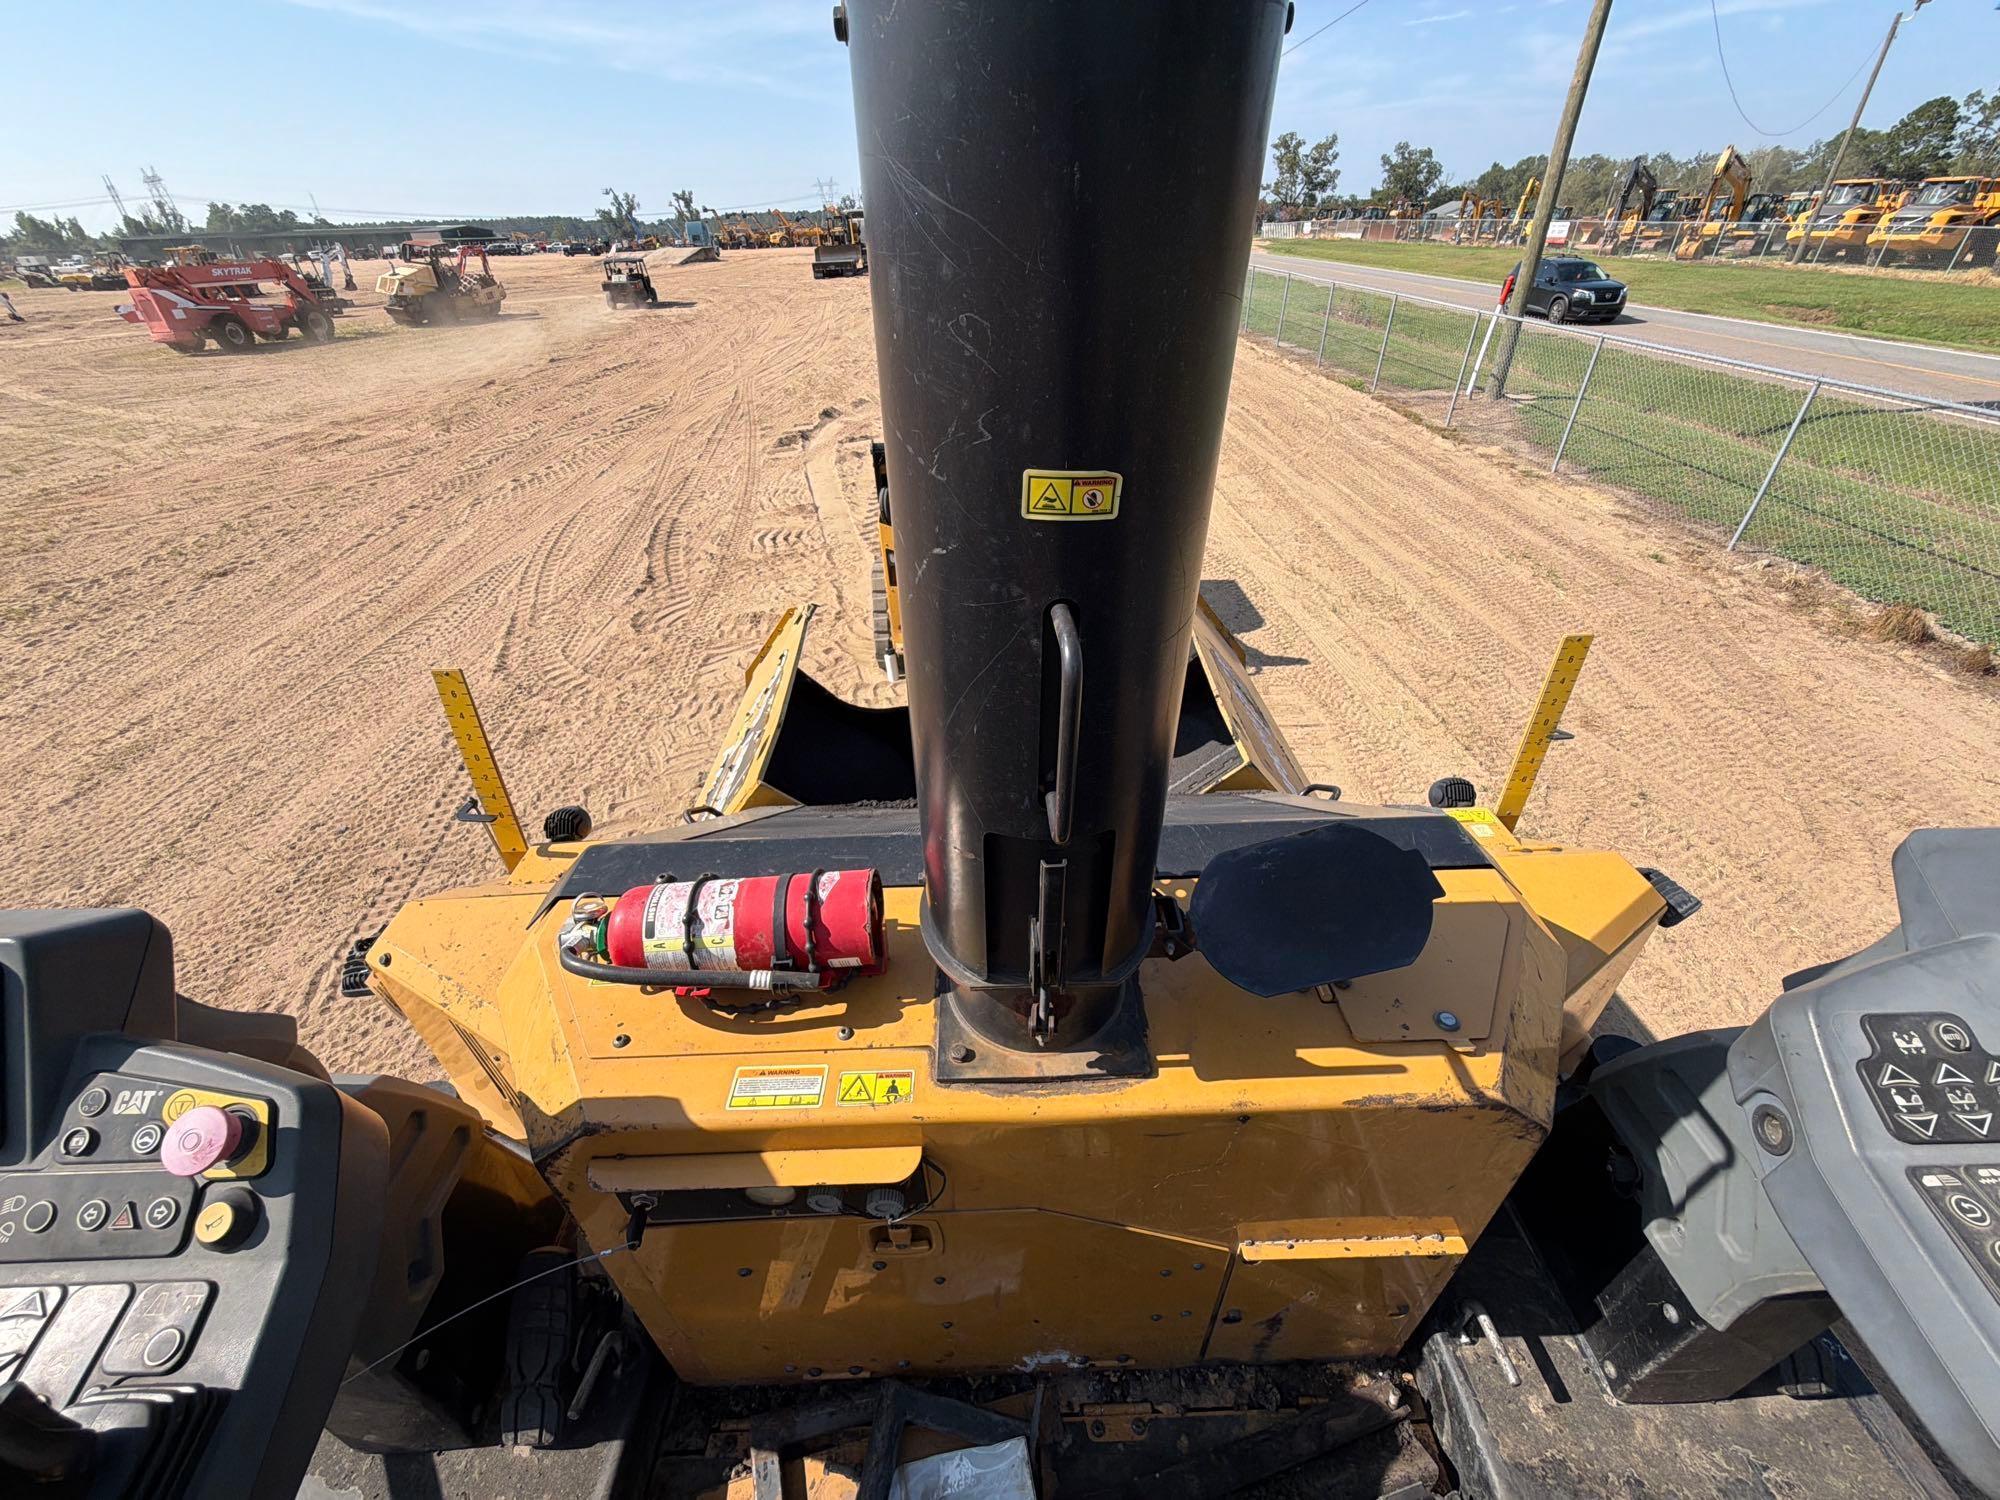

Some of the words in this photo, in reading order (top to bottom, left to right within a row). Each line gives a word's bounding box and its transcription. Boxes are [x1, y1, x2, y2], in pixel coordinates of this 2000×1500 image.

[211, 267, 252, 276] SKYTRAK
[451, 690, 457, 698] 6
[466, 733, 472, 741] 2
[113, 1091, 156, 1114] CAT
